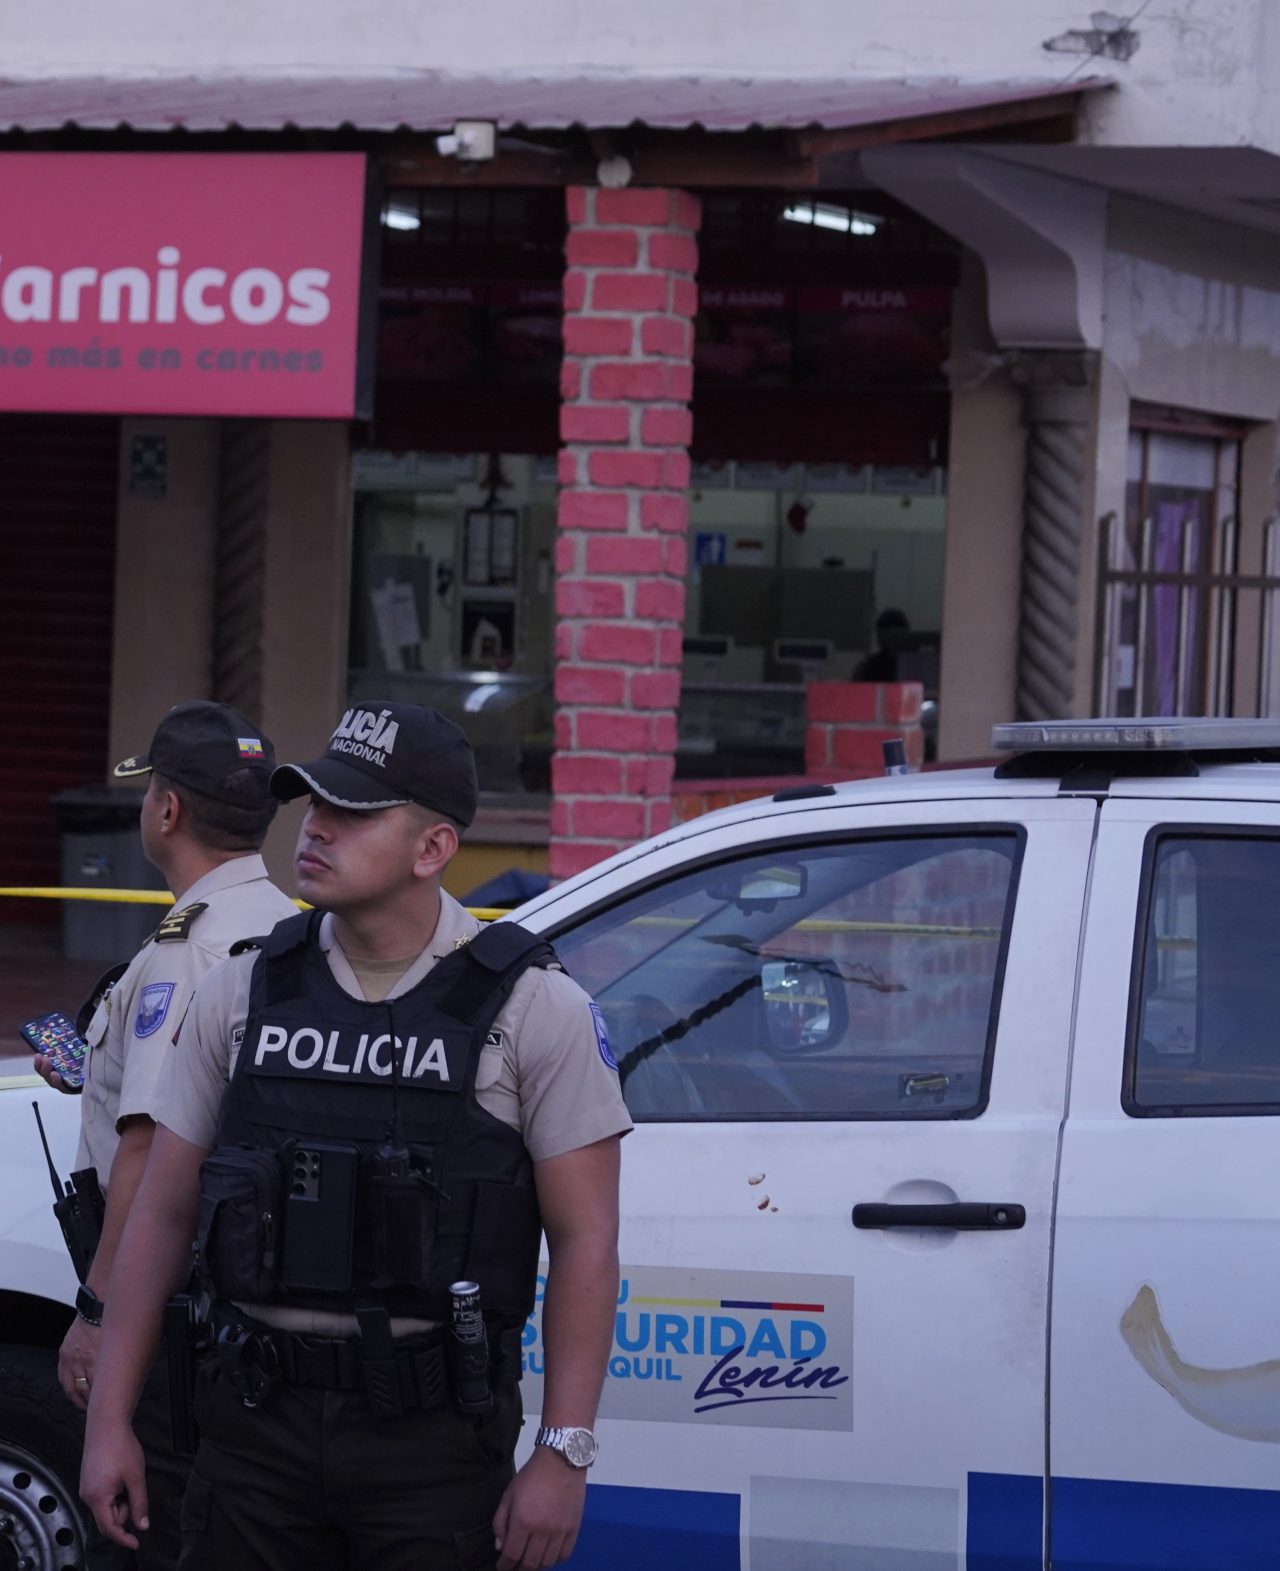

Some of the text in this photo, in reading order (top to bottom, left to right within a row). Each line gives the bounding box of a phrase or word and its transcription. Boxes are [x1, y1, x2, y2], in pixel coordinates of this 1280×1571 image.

[841, 290, 907, 308] PULPA
[47, 336, 123, 371] más
[136, 347, 182, 371] en
[195, 348, 325, 373] carnes
[330, 709, 400, 755] LICÍA
[330, 738, 386, 769] NACIONAL
[254, 1025, 450, 1082] POLICIA
